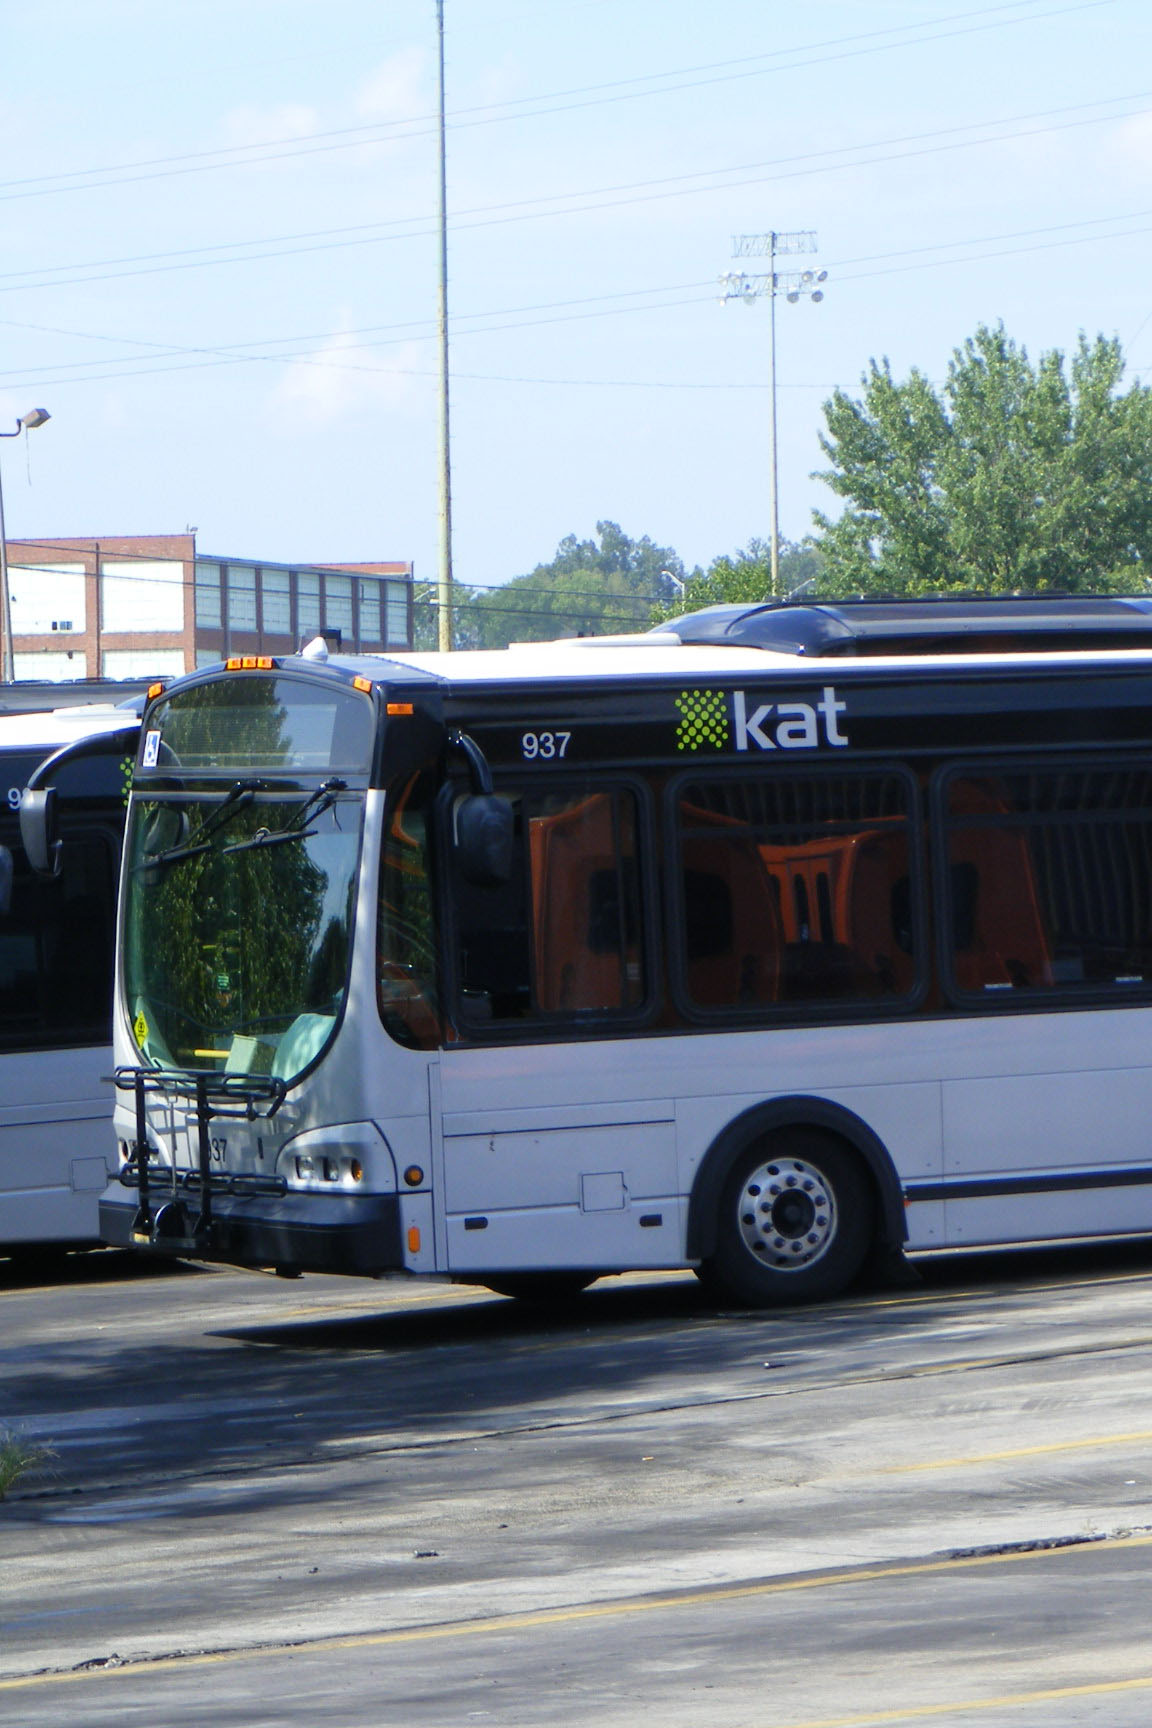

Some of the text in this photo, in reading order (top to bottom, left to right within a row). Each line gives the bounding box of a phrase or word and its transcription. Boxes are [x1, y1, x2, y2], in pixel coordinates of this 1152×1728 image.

[733, 686, 849, 751] kat
[522, 731, 571, 759] 937
[208, 1137, 228, 1162] 37
